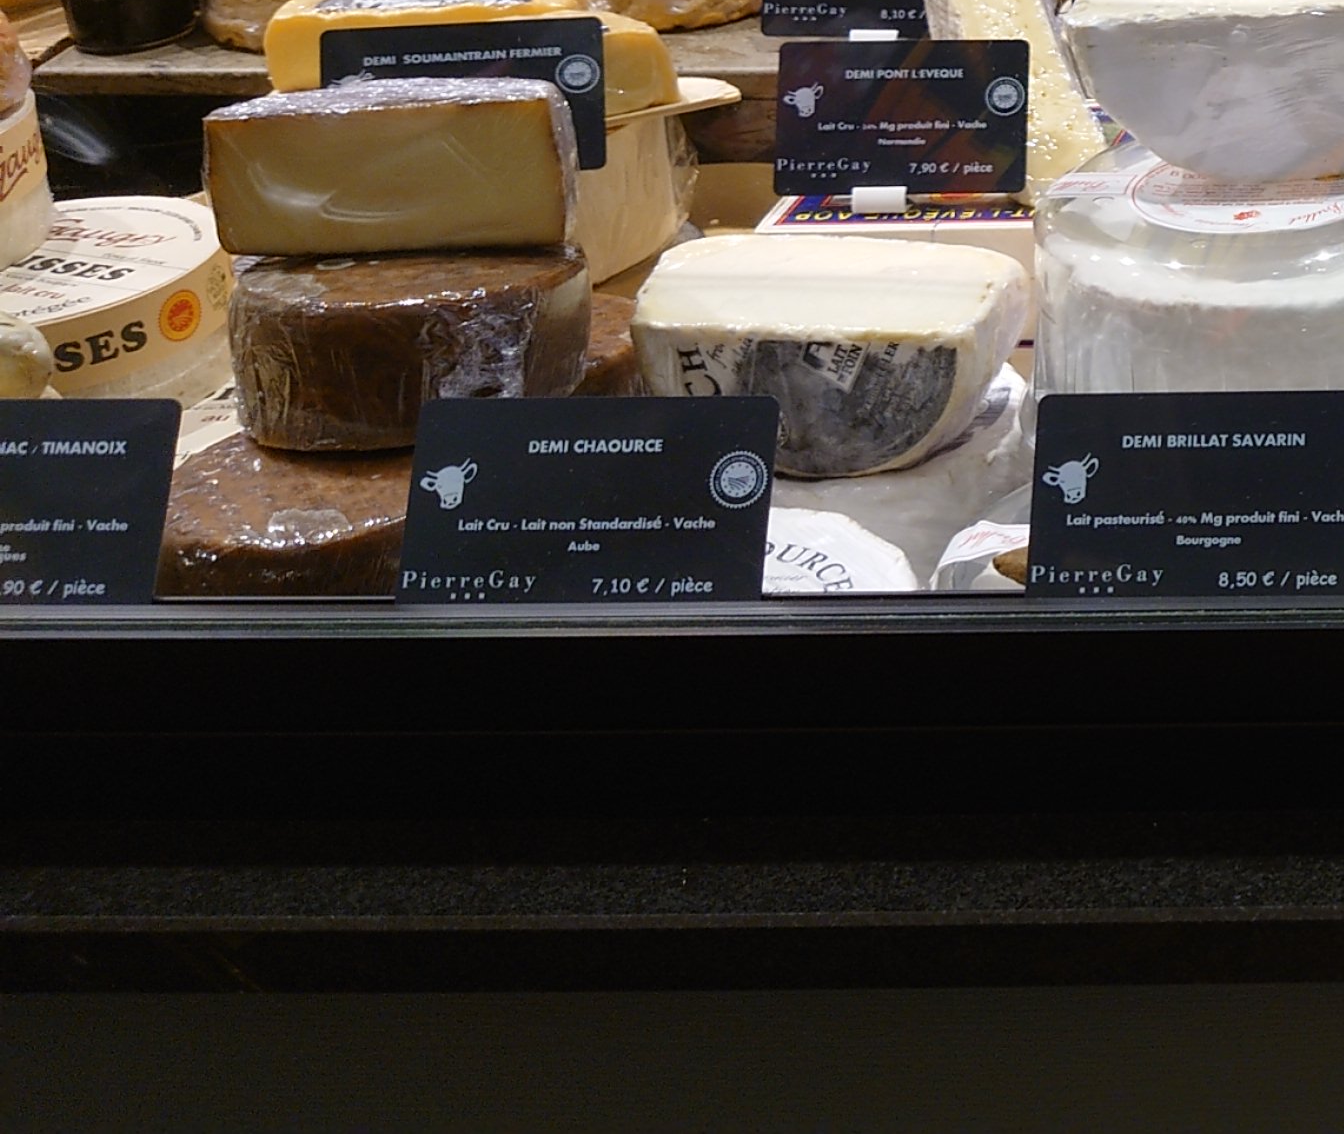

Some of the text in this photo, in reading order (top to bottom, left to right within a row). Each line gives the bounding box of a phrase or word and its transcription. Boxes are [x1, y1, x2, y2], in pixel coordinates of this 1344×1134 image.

[764, 3, 847, 16] PierreGay
[364, 47, 562, 66] DEMI SOUMAINTRAIN FERMIER
[846, 70, 909, 79] DEMI PONT
[958, 120, 987, 128] Vache
[776, 159, 870, 172] PierreGay
[910, 162, 992, 175] 7,90 pièce
[54, 320, 147, 372] SES
[42, 441, 126, 454] TIMANOIX
[529, 439, 663, 453] DEMI CHAOURCE
[1123, 433, 1305, 448] DEMI BRILLAT SAVARIN
[53, 519, 128, 531] fini Vache
[458, 516, 715, 530] Lait Cru Lait non Standardisé Vache
[1067, 514, 1091, 525] Lait
[1094, 511, 1164, 528] pasteurisé
[1201, 512, 1222, 526] Mg
[1226, 511, 1275, 526] produit
[1279, 511, 1299, 522] fini
[568, 541, 600, 551] Aube
[1176, 535, 1241, 547] Bourgogne
[403, 570, 535, 592] PierreGay
[1031, 564, 1163, 586] PierreGay
[1219, 570, 1337, 589] 8,50 pièce
[63, 579, 105, 598] pièce
[593, 577, 712, 596] 7,10 pièce
